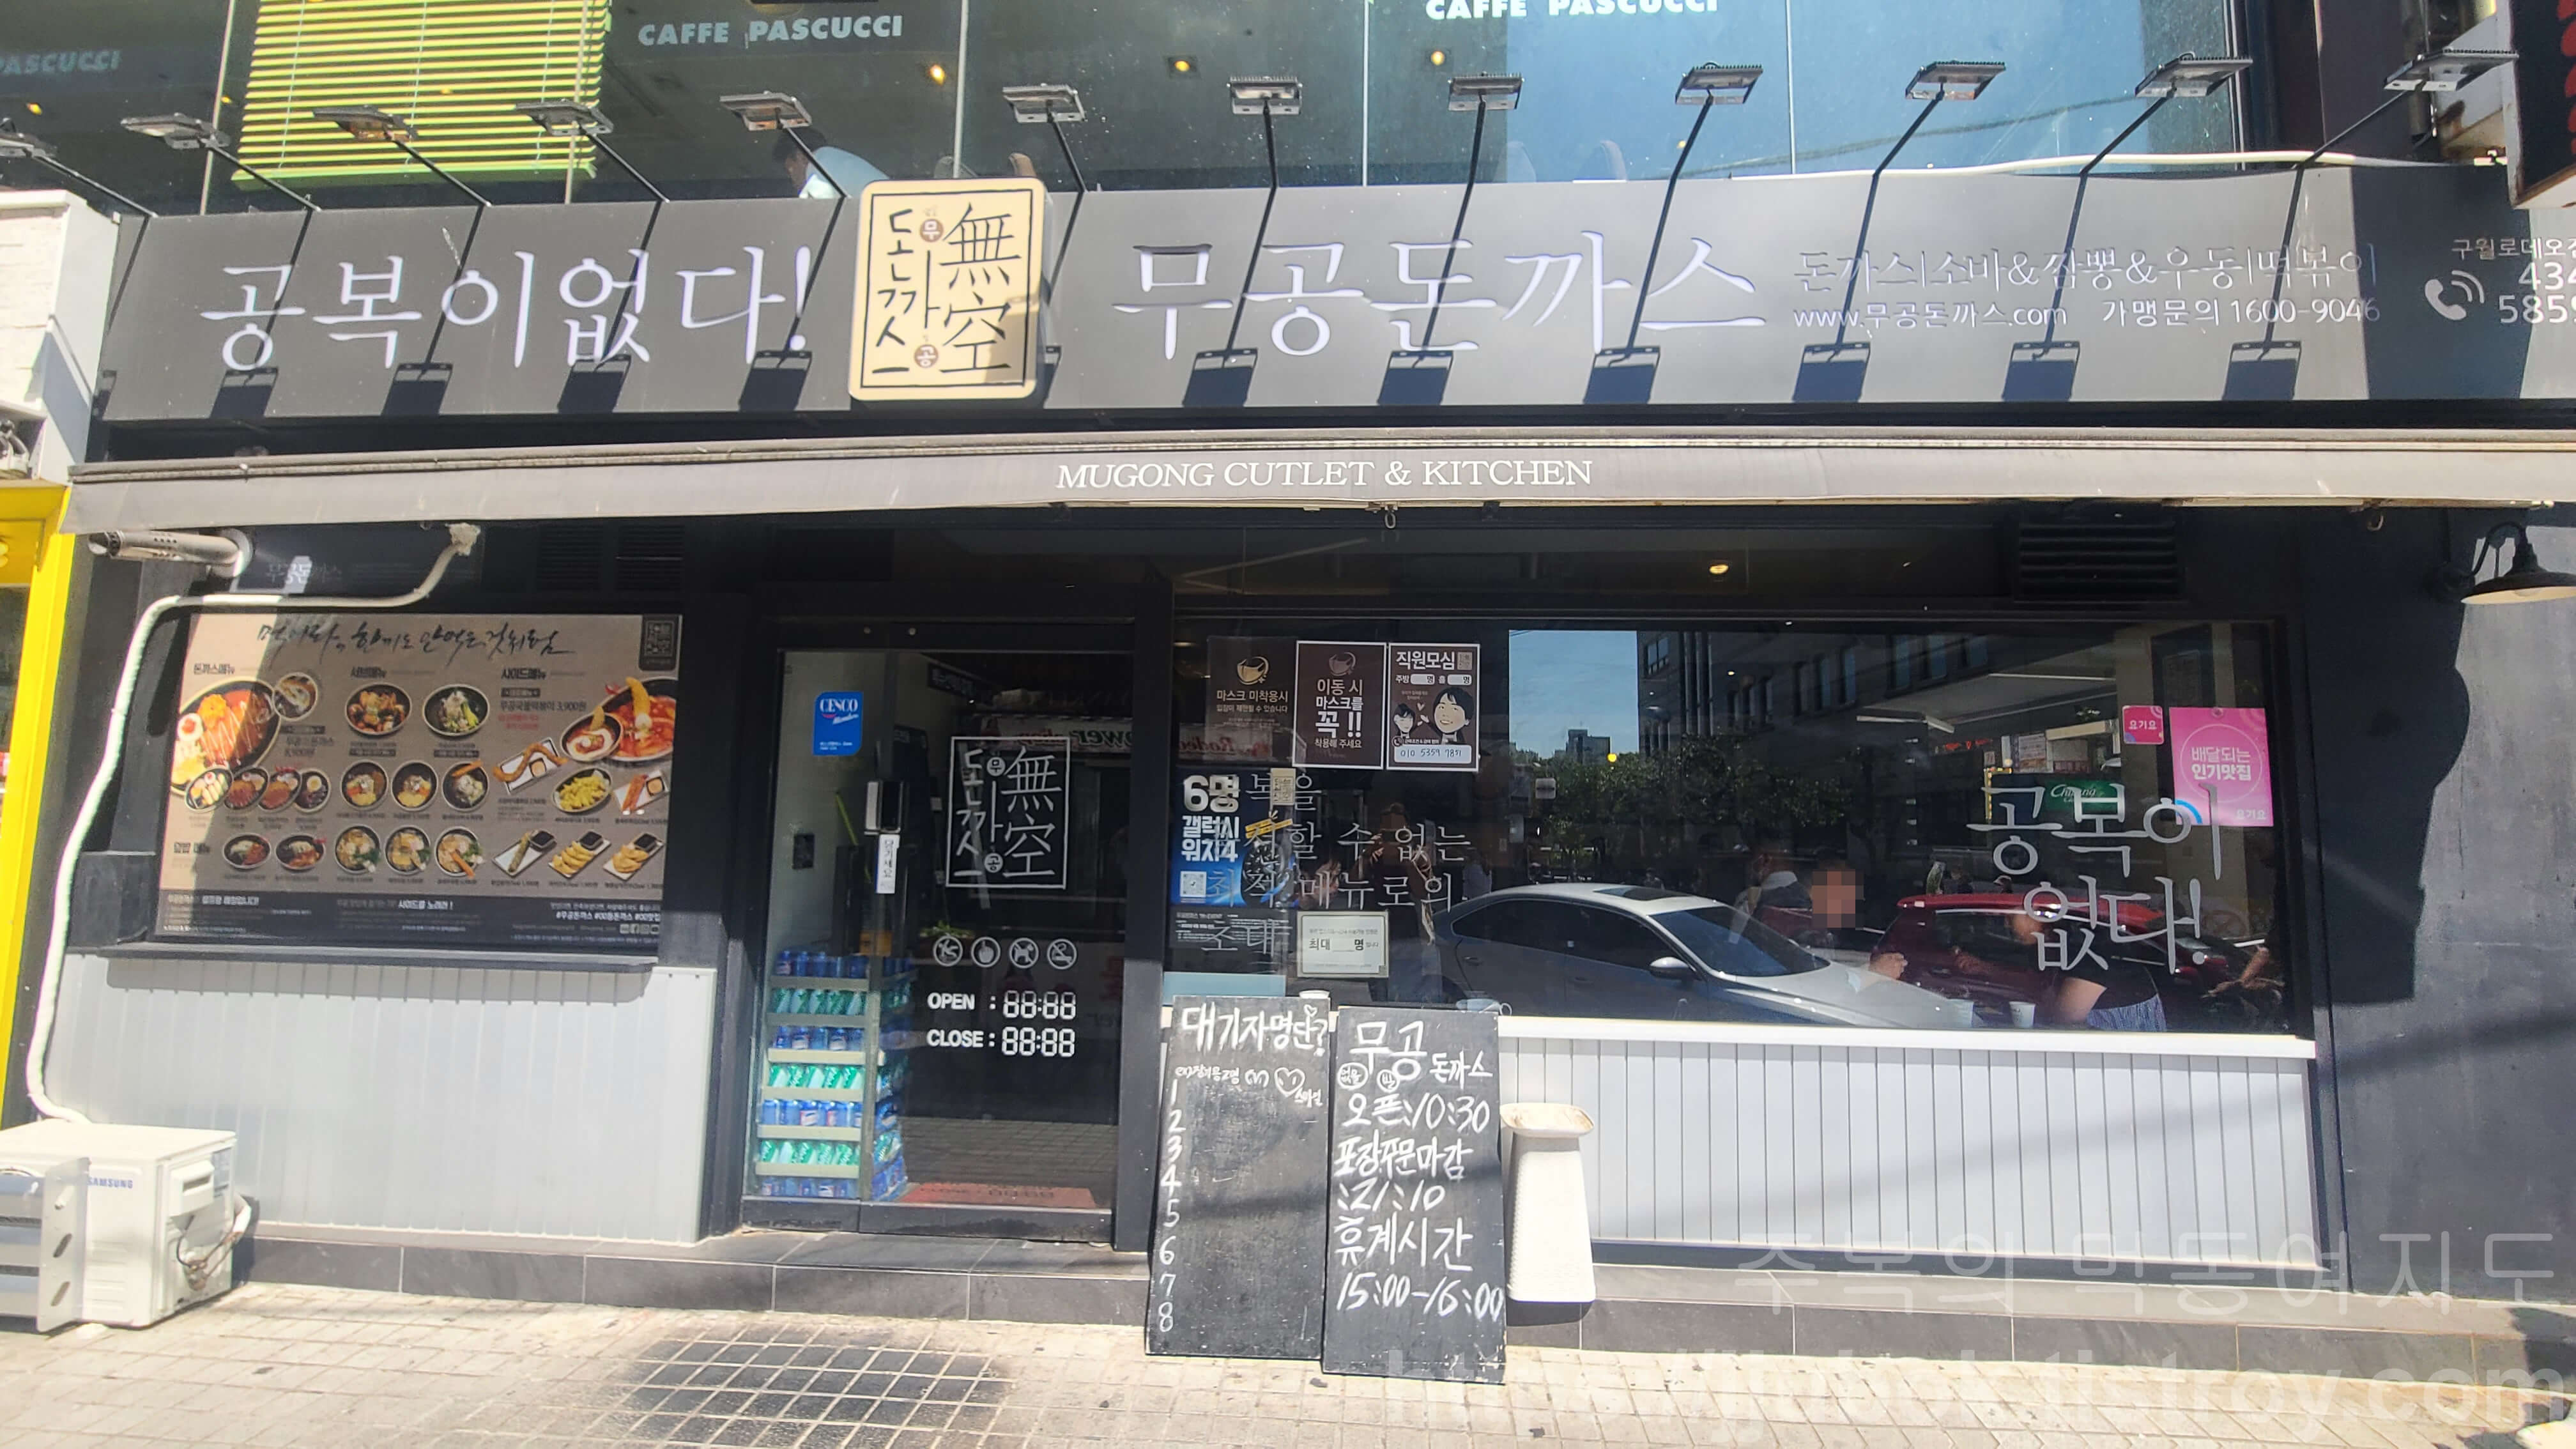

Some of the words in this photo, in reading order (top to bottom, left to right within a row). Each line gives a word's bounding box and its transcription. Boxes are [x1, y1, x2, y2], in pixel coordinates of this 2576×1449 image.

[1426, 0, 1528, 20] CAFFE
[1548, 0, 1717, 16] PASCUCCI
[639, 22, 729, 46] CAFFE
[748, 15, 903, 42] PASCUCCI
[1112, 230, 1766, 360] 무공돈까스
[1793, 301, 2068, 328] www.무공돈까스.com
[2103, 298, 2220, 327] 가맹문의
[2232, 298, 2380, 323] 1600-9046
[1057, 462, 1215, 489] MUGONG
[1223, 460, 1374, 487] CUTLET
[1384, 461, 1412, 486] &
[1422, 459, 1593, 486] KITCHEN
[1396, 650, 1455, 670] 직원모심
[1216, 690, 1246, 702] 마스크
[1249, 690, 1289, 703] 미착용시
[1317, 678, 1346, 695] 이동
[1349, 678, 1363, 696] 시
[1315, 696, 1364, 712] 마스크를
[1315, 711, 1340, 739] 꼭
[2129, 719, 2158, 730] 요기요
[1315, 738, 1338, 748] 착용해
[1339, 739, 1362, 749] 주세요
[2191, 746, 2251, 763] 배달되는
[2191, 763, 2251, 782] 인기맛집
[1184, 774, 1240, 813] 6명
[1182, 815, 1239, 838] 갤럭시
[2236, 808, 2267, 821] 요기요
[1966, 782, 2222, 880] 공복이
[1181, 839, 1239, 862] 워치4
[2023, 875, 2206, 975] 없다!
[1309, 939, 1330, 951] 최대
[1354, 939, 1364, 951] 명
[927, 992, 975, 1010] OPEN
[926, 1029, 984, 1048] CLOSE
[1182, 1001, 1328, 1057] 대기자명단?
[1349, 1020, 1427, 1081] 무공
[1430, 1050, 1493, 1090] 돈까스
[1170, 1078, 1179, 1106] 1
[1167, 1110, 1186, 1134] 2
[1168, 1140, 1183, 1164] 3
[88, 1177, 134, 1189] SAMSUNG
[1160, 1167, 1182, 1197] 4
[1163, 1200, 1180, 1227] 5
[1159, 1236, 1177, 1266] 6
[1160, 1274, 1177, 1297] 7
[1158, 1301, 1174, 1332] 8
